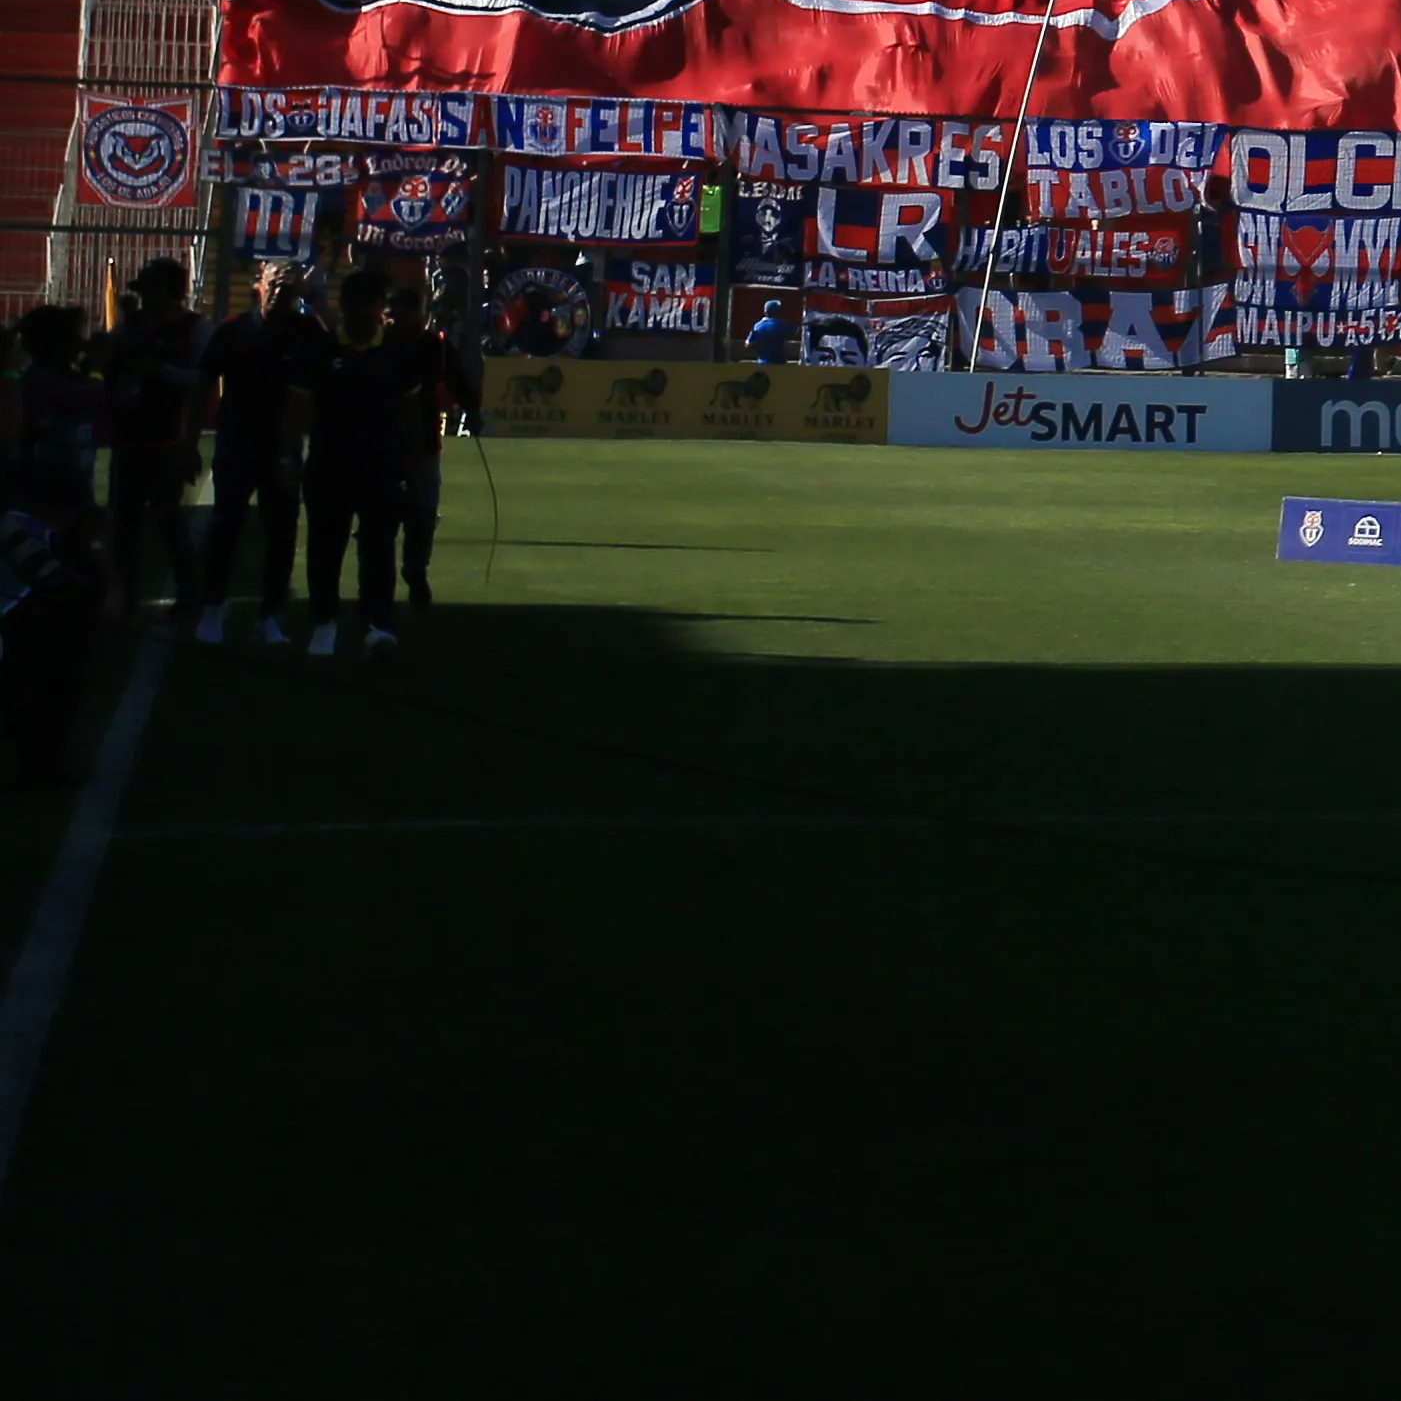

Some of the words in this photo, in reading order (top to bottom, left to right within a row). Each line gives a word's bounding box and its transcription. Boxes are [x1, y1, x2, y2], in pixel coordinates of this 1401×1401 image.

[217, 87, 287, 137] LOS
[437, 93, 528, 149] SAN
[566, 100, 705, 157] FELIPE
[712, 103, 1003, 191] MASAKRES
[1026, 117, 1103, 169] LOS
[502, 164, 671, 243] PANQUEHUE
[816, 185, 943, 264] LR
[803, 260, 837, 289] LA
[952, 226, 1150, 278] HABITUALES
[631, 261, 697, 297] SAN
[605, 291, 712, 334] KAMILO
[1236, 306, 1336, 348] MAIPU
[954, 381, 1208, 444] JetSMART
